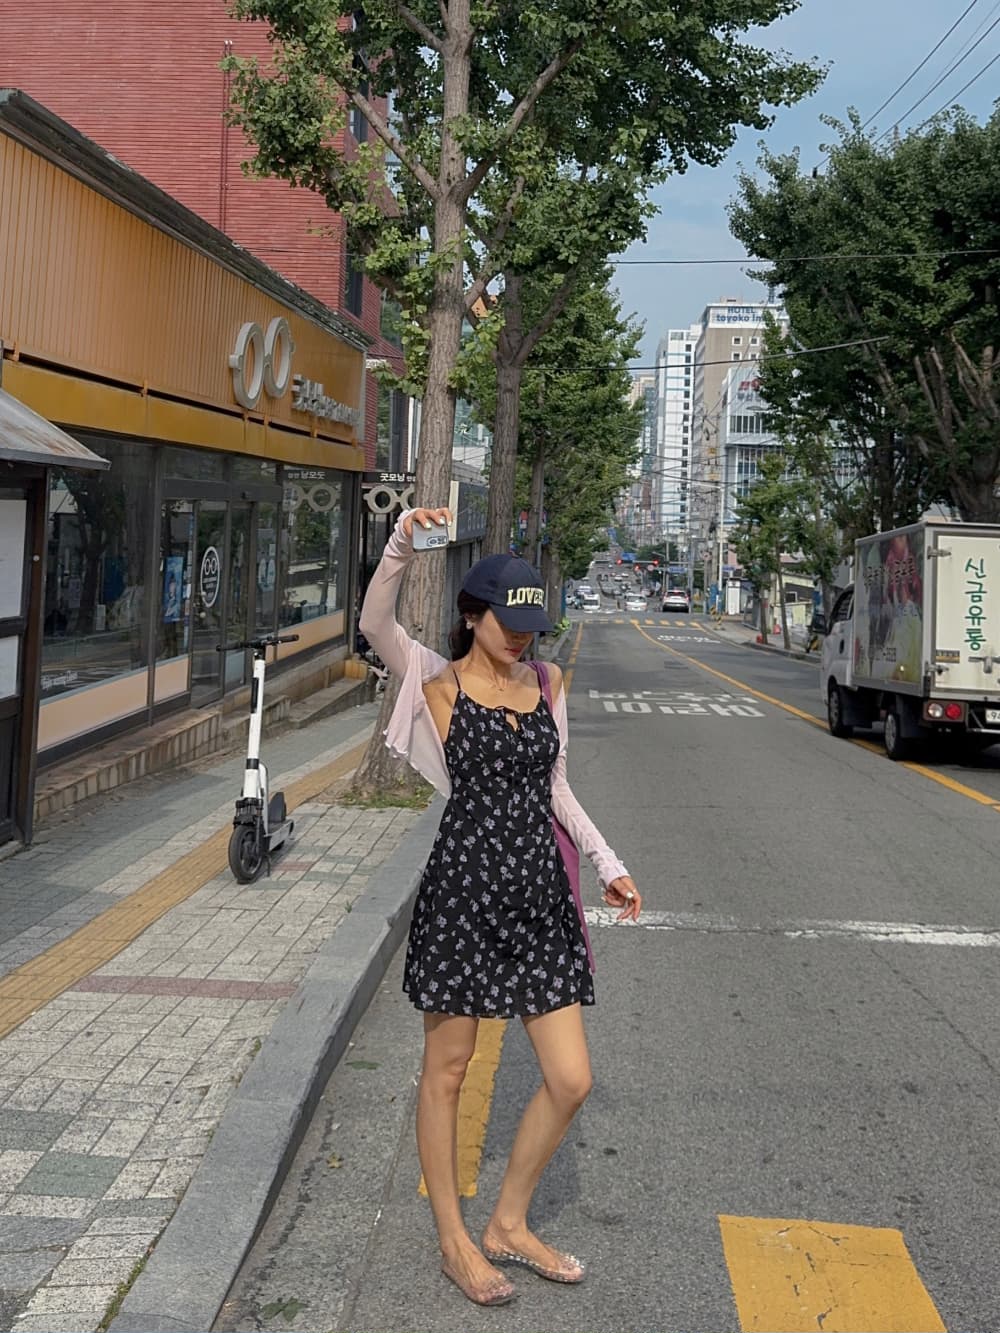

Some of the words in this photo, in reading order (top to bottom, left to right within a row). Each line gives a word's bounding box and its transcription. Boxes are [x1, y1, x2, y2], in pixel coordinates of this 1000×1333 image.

[727, 306, 758, 314] HOTEL
[716, 314, 750, 323] toyoko
[380, 473, 405, 482] 굿모닝
[964, 558, 987, 651] 신금유통
[603, 701, 766, 717] 어린이
